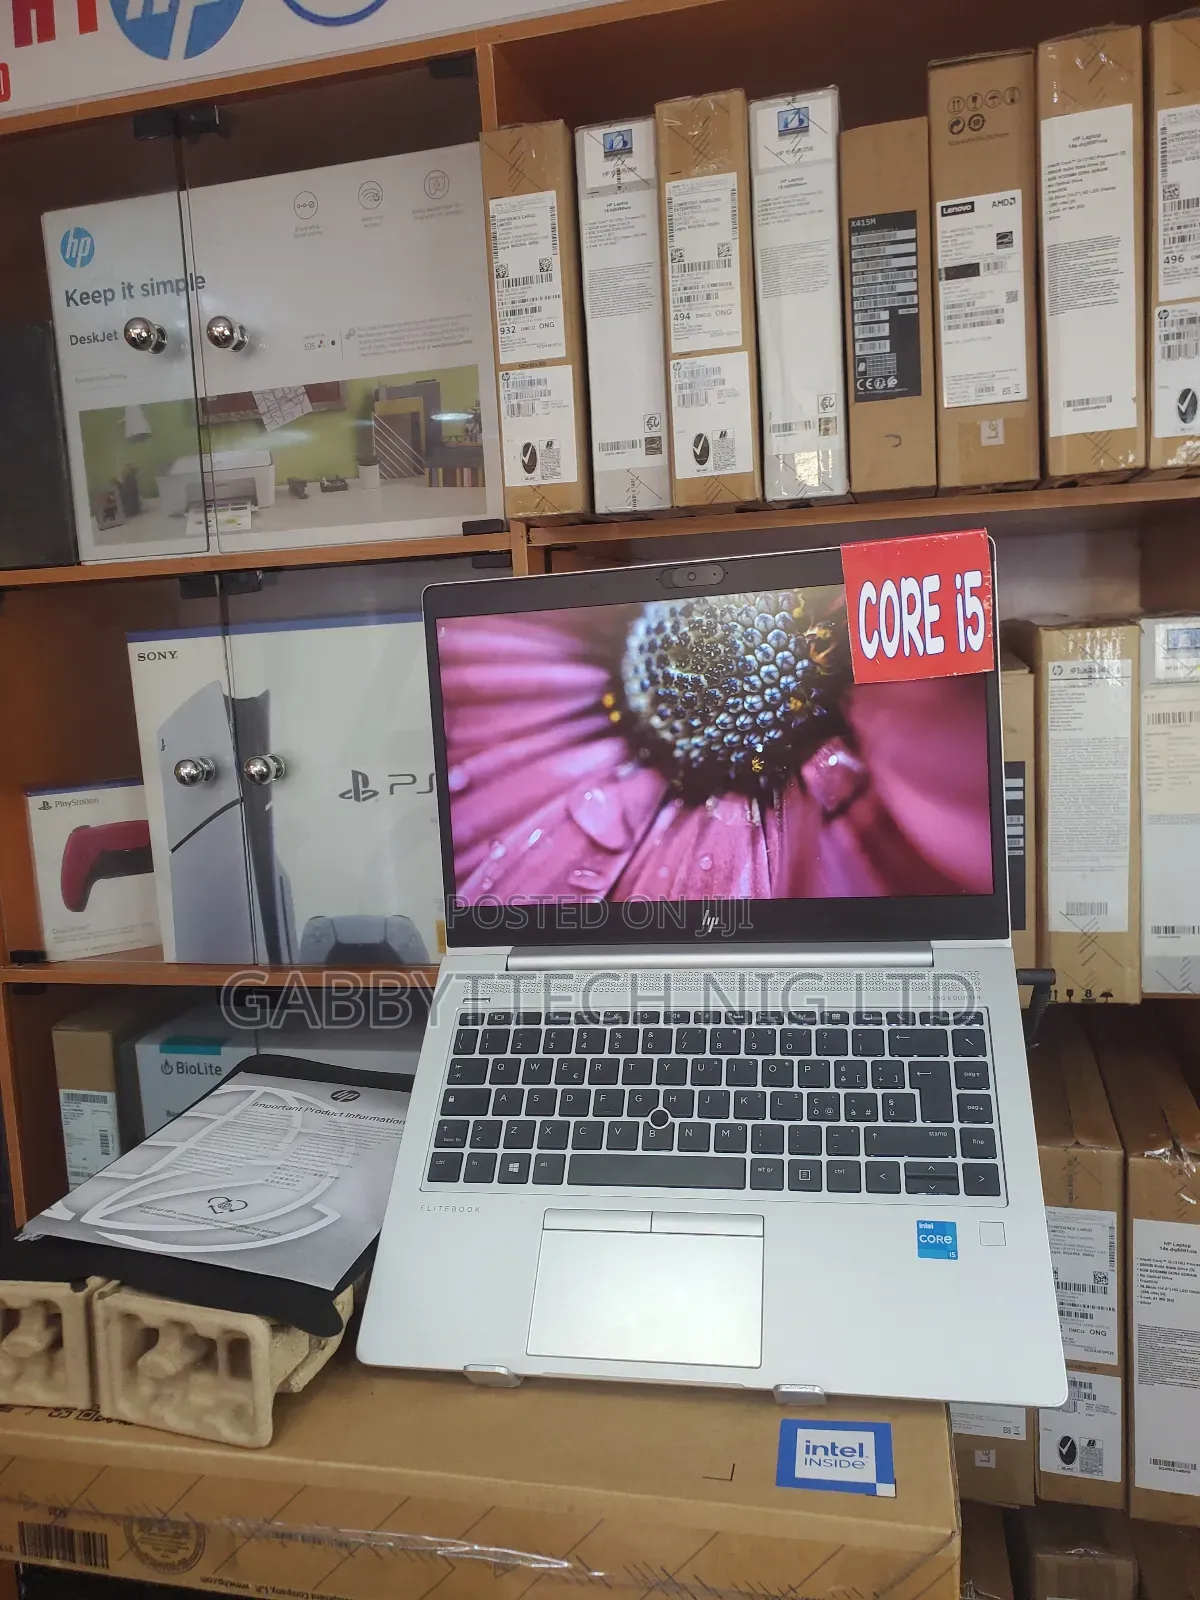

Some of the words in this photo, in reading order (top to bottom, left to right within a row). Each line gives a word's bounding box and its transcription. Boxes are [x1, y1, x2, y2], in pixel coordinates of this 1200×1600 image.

[943, 204, 972, 214] Lenovo
[992, 198, 1010, 208] AMD
[60, 227, 95, 268] hp
[1164, 254, 1185, 265] 496
[65, 287, 116, 307] Keep
[121, 282, 134, 300] it
[141, 273, 206, 297] simple
[674, 312, 690, 321] 494
[715, 308, 732, 316] ONG
[70, 330, 118, 346] DeskJet
[500, 326, 516, 335] 932
[858, 573, 946, 660] CORE
[954, 570, 986, 654] i5
[137, 650, 178, 662] SONY
[54, 797, 100, 808] PlayStation
[702, 910, 720, 932] hp
[176, 1061, 222, 1076] BioLite
[497, 1063, 505, 1071] Q
[252, 1102, 302, 1112] Important
[304, 1106, 344, 1118] Product
[344, 1112, 406, 1125] Information
[420, 1205, 481, 1213] ELITEBOOK
[804, 1440, 864, 1458] intel
[804, 1458, 866, 1470] INSIDE
